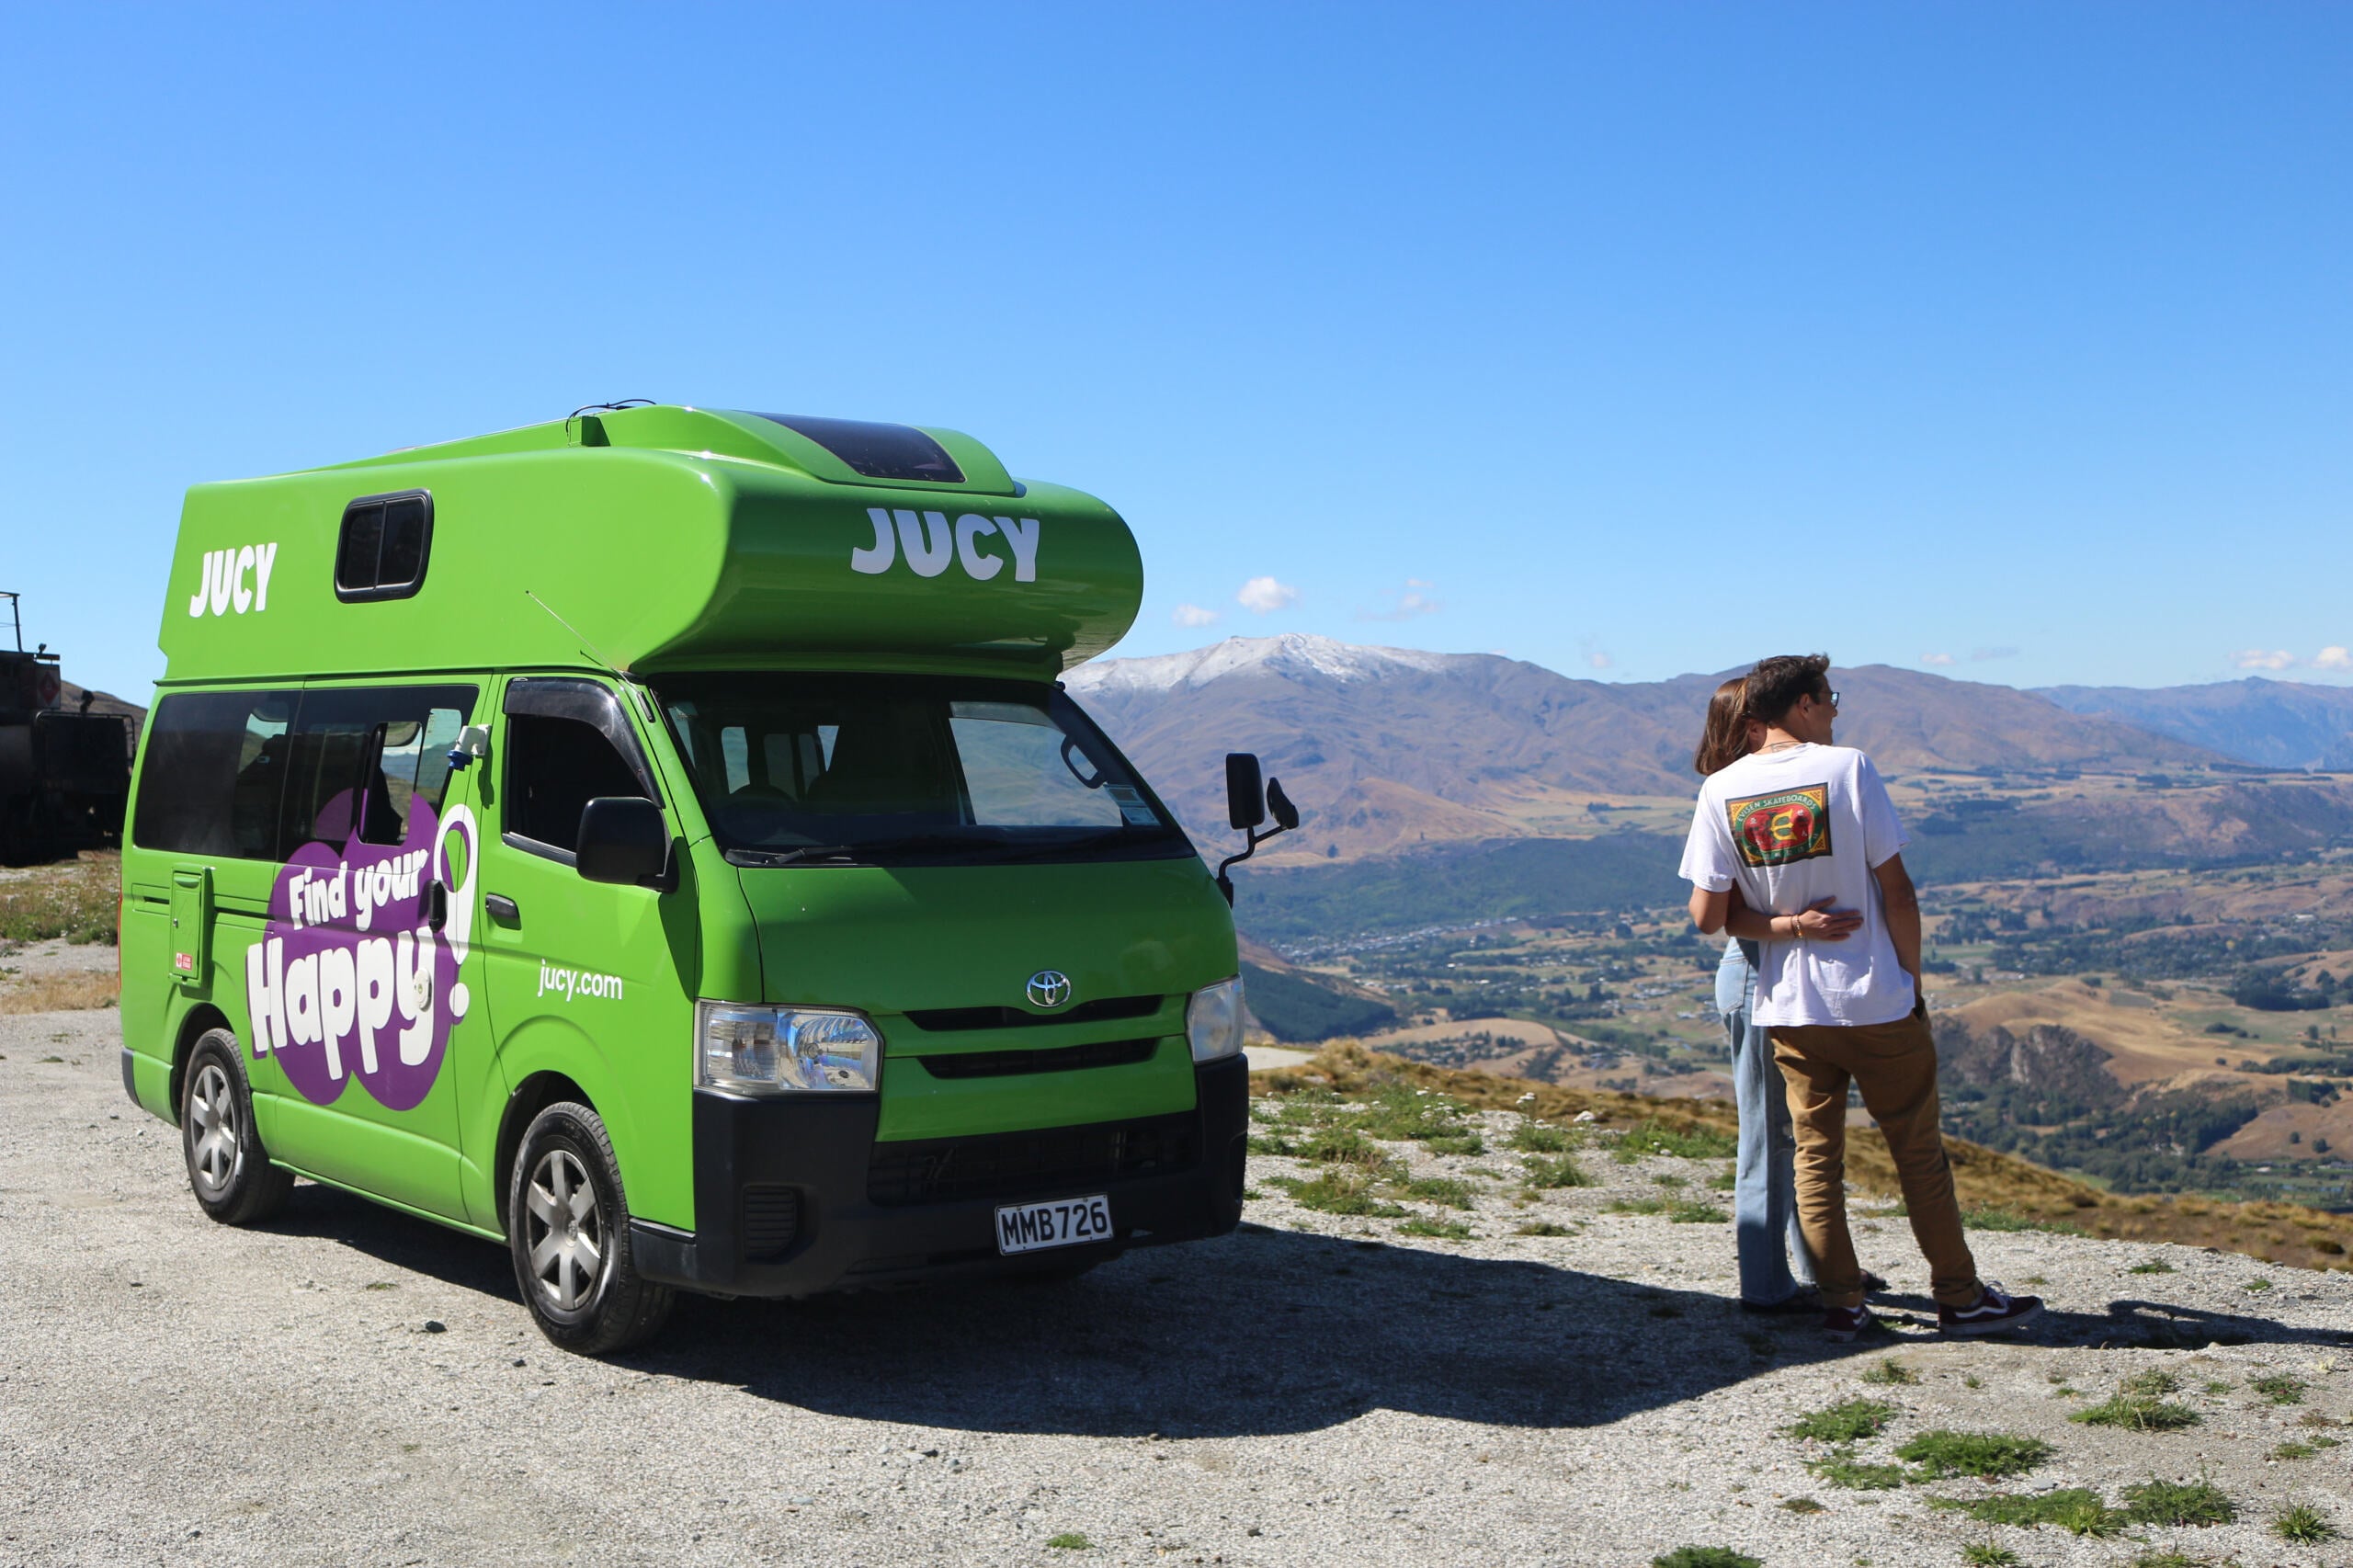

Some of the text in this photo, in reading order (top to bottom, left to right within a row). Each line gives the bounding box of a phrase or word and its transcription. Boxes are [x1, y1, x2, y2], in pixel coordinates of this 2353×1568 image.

[851, 507, 1040, 583] JUCY
[189, 542, 278, 618] JUCY
[1763, 794, 1816, 810] SKATEBOARDS
[289, 848, 429, 931] Find your
[537, 958, 623, 1002] jucy.com
[1002, 1201, 1108, 1245] MMB726
